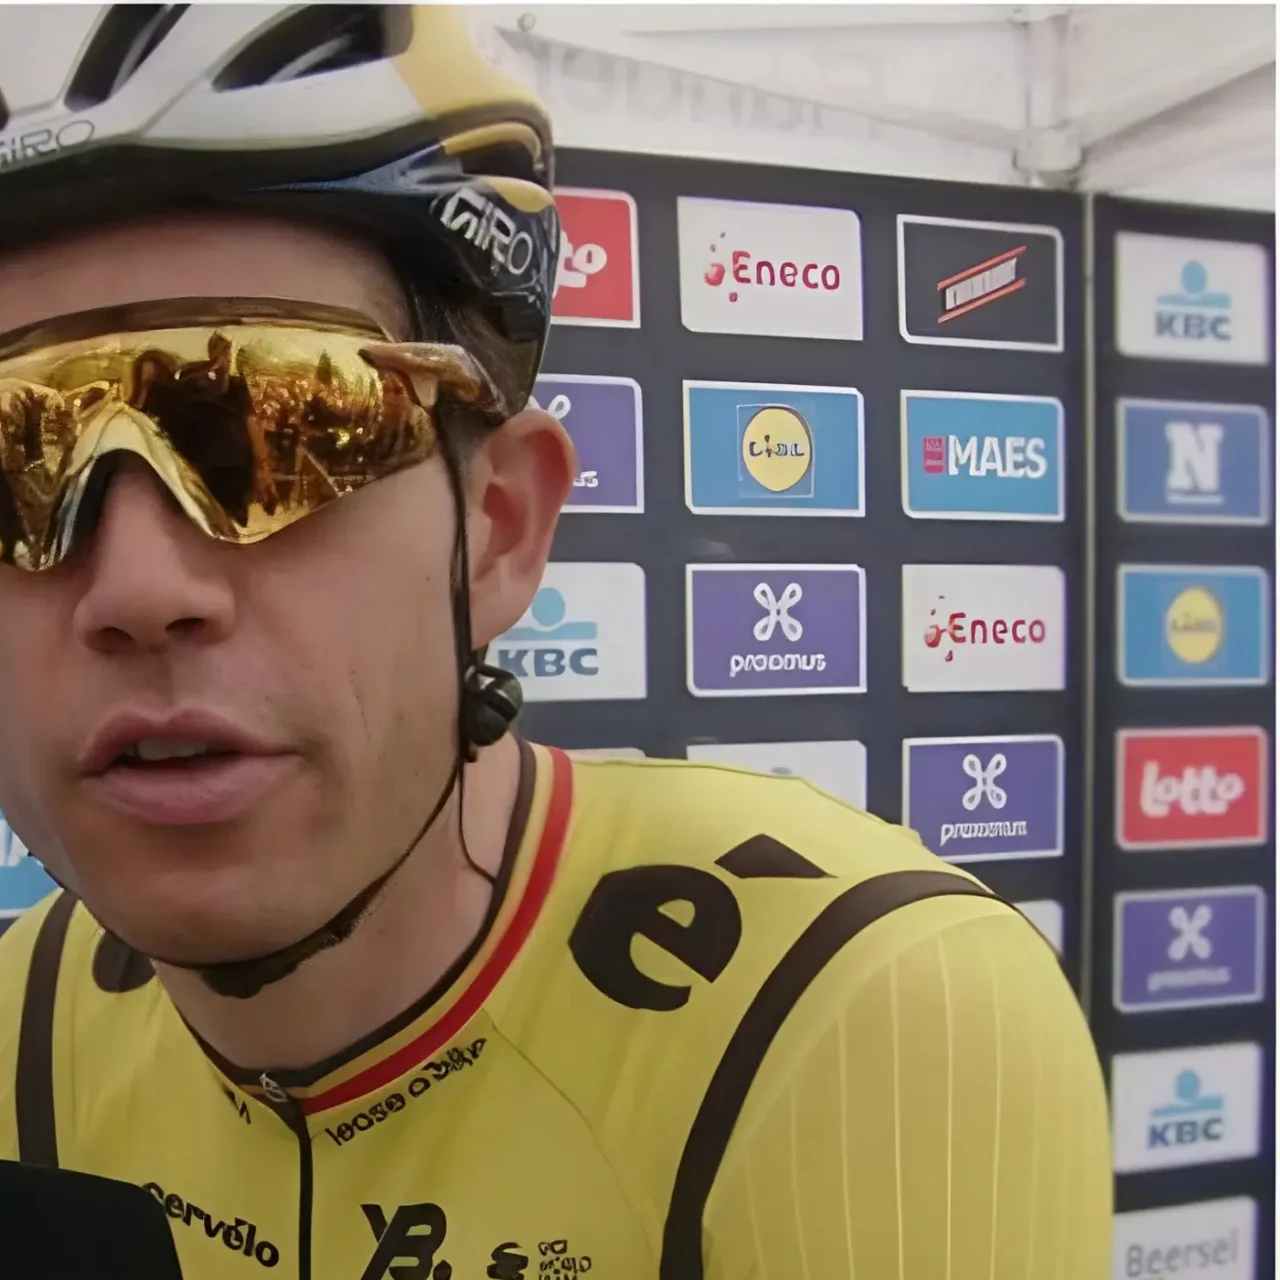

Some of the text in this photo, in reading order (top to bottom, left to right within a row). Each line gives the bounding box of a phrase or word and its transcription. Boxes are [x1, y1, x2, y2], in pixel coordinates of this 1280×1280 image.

[732, 251, 841, 290] Eneco
[1154, 311, 1232, 341] KBC
[948, 434, 1049, 479] MAES
[947, 612, 1047, 646] Eneco
[497, 647, 599, 678] KBC
[1147, 1116, 1225, 1149] KBC
[1126, 1228, 1239, 1279] Beersel
